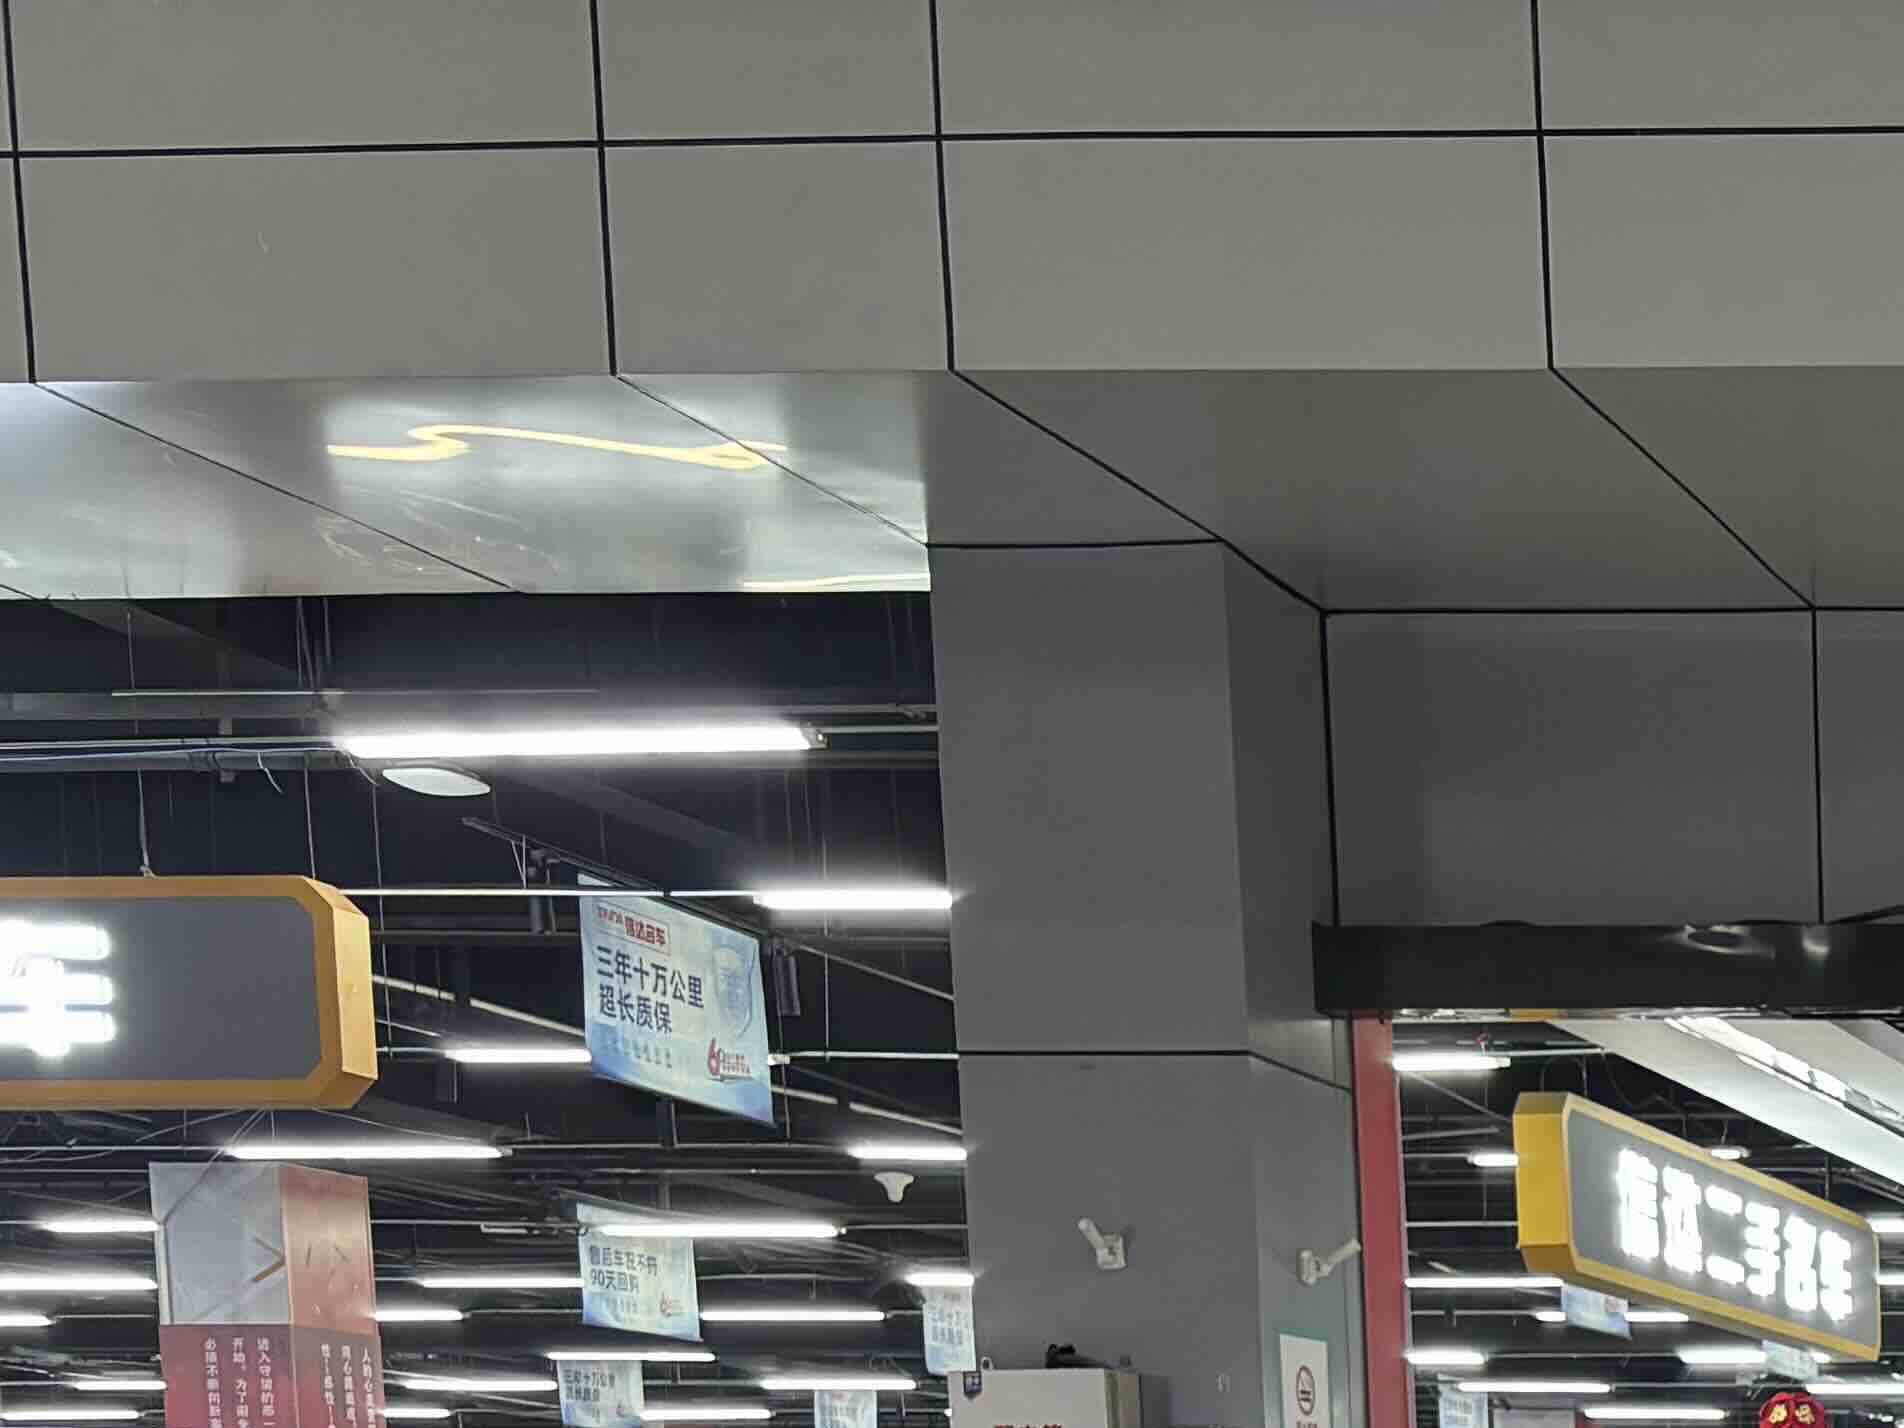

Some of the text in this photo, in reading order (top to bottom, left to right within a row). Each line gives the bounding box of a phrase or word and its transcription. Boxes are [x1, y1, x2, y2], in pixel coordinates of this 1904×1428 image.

[597, 945, 704, 1009] 三年十万公里
[600, 983, 673, 1034] 超长质保
